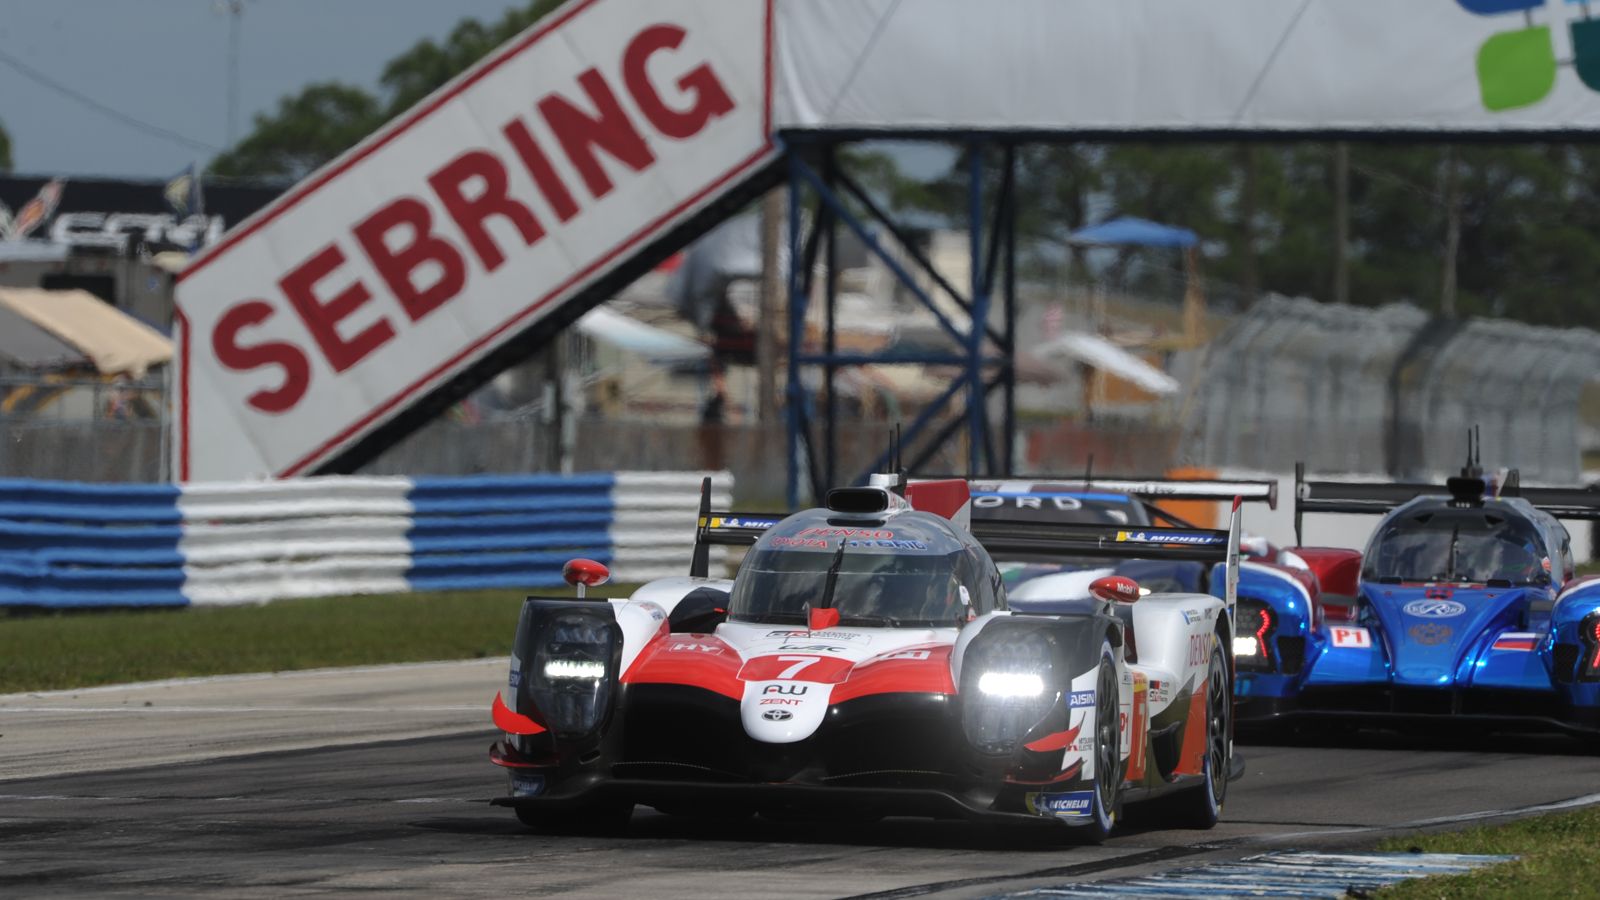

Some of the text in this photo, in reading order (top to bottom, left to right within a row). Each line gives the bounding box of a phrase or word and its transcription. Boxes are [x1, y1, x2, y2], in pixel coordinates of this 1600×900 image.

[211, 23, 736, 414] SEBRING
[974, 495, 1082, 511] ORD
[800, 528, 894, 540] DENSO
[1150, 535, 1223, 543] MICHELIN
[1335, 629, 1364, 645] P1
[777, 655, 821, 679] 7
[760, 698, 803, 706] ZENT
[1069, 693, 1095, 706] AISIN
[1050, 798, 1090, 809] MICHELIN
